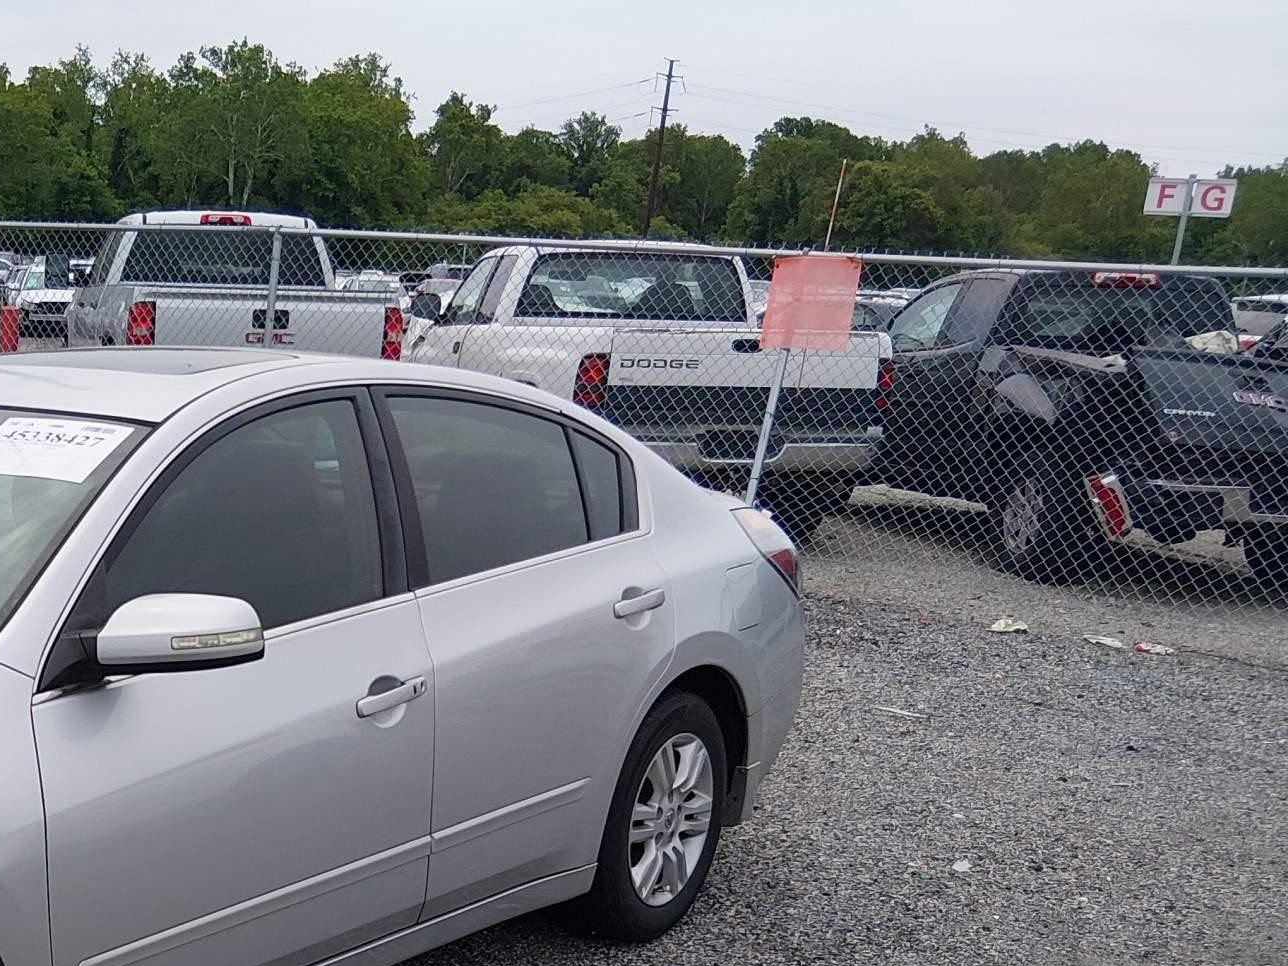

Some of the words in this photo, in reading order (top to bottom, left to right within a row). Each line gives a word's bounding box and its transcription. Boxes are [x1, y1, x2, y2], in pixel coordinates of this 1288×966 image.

[1156, 184, 1177, 208] F
[1200, 185, 1227, 211] G
[619, 359, 700, 369] DODGE
[3, 429, 105, 448] 45338427
